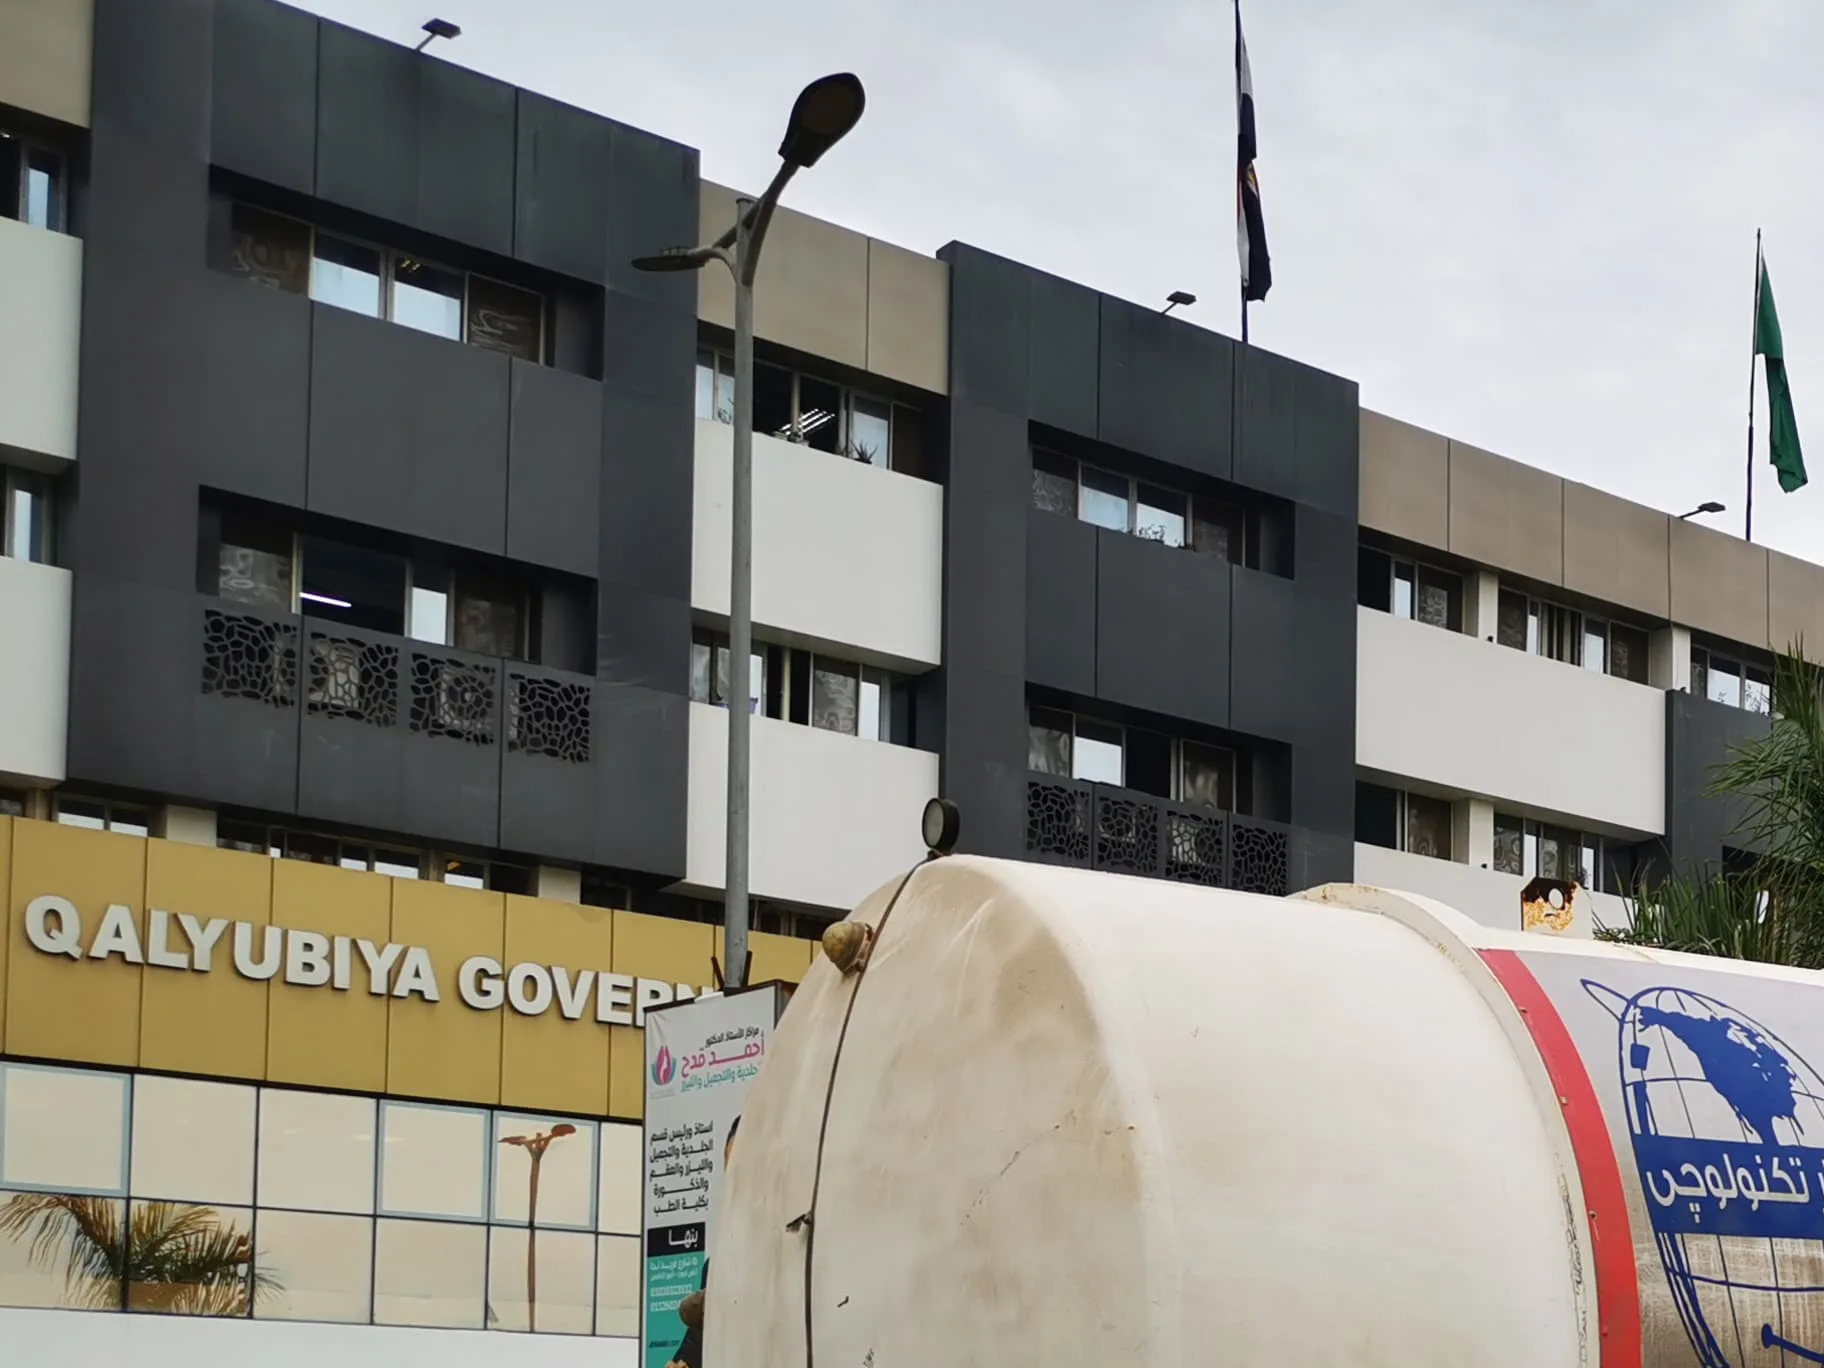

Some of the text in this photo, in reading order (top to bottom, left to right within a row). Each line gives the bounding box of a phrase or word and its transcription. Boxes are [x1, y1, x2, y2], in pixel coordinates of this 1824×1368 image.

[25, 895, 718, 1028] QALYUBIYA GOVER
[650, 1128, 668, 1146] قسم
[653, 1199, 681, 1217] الطب
